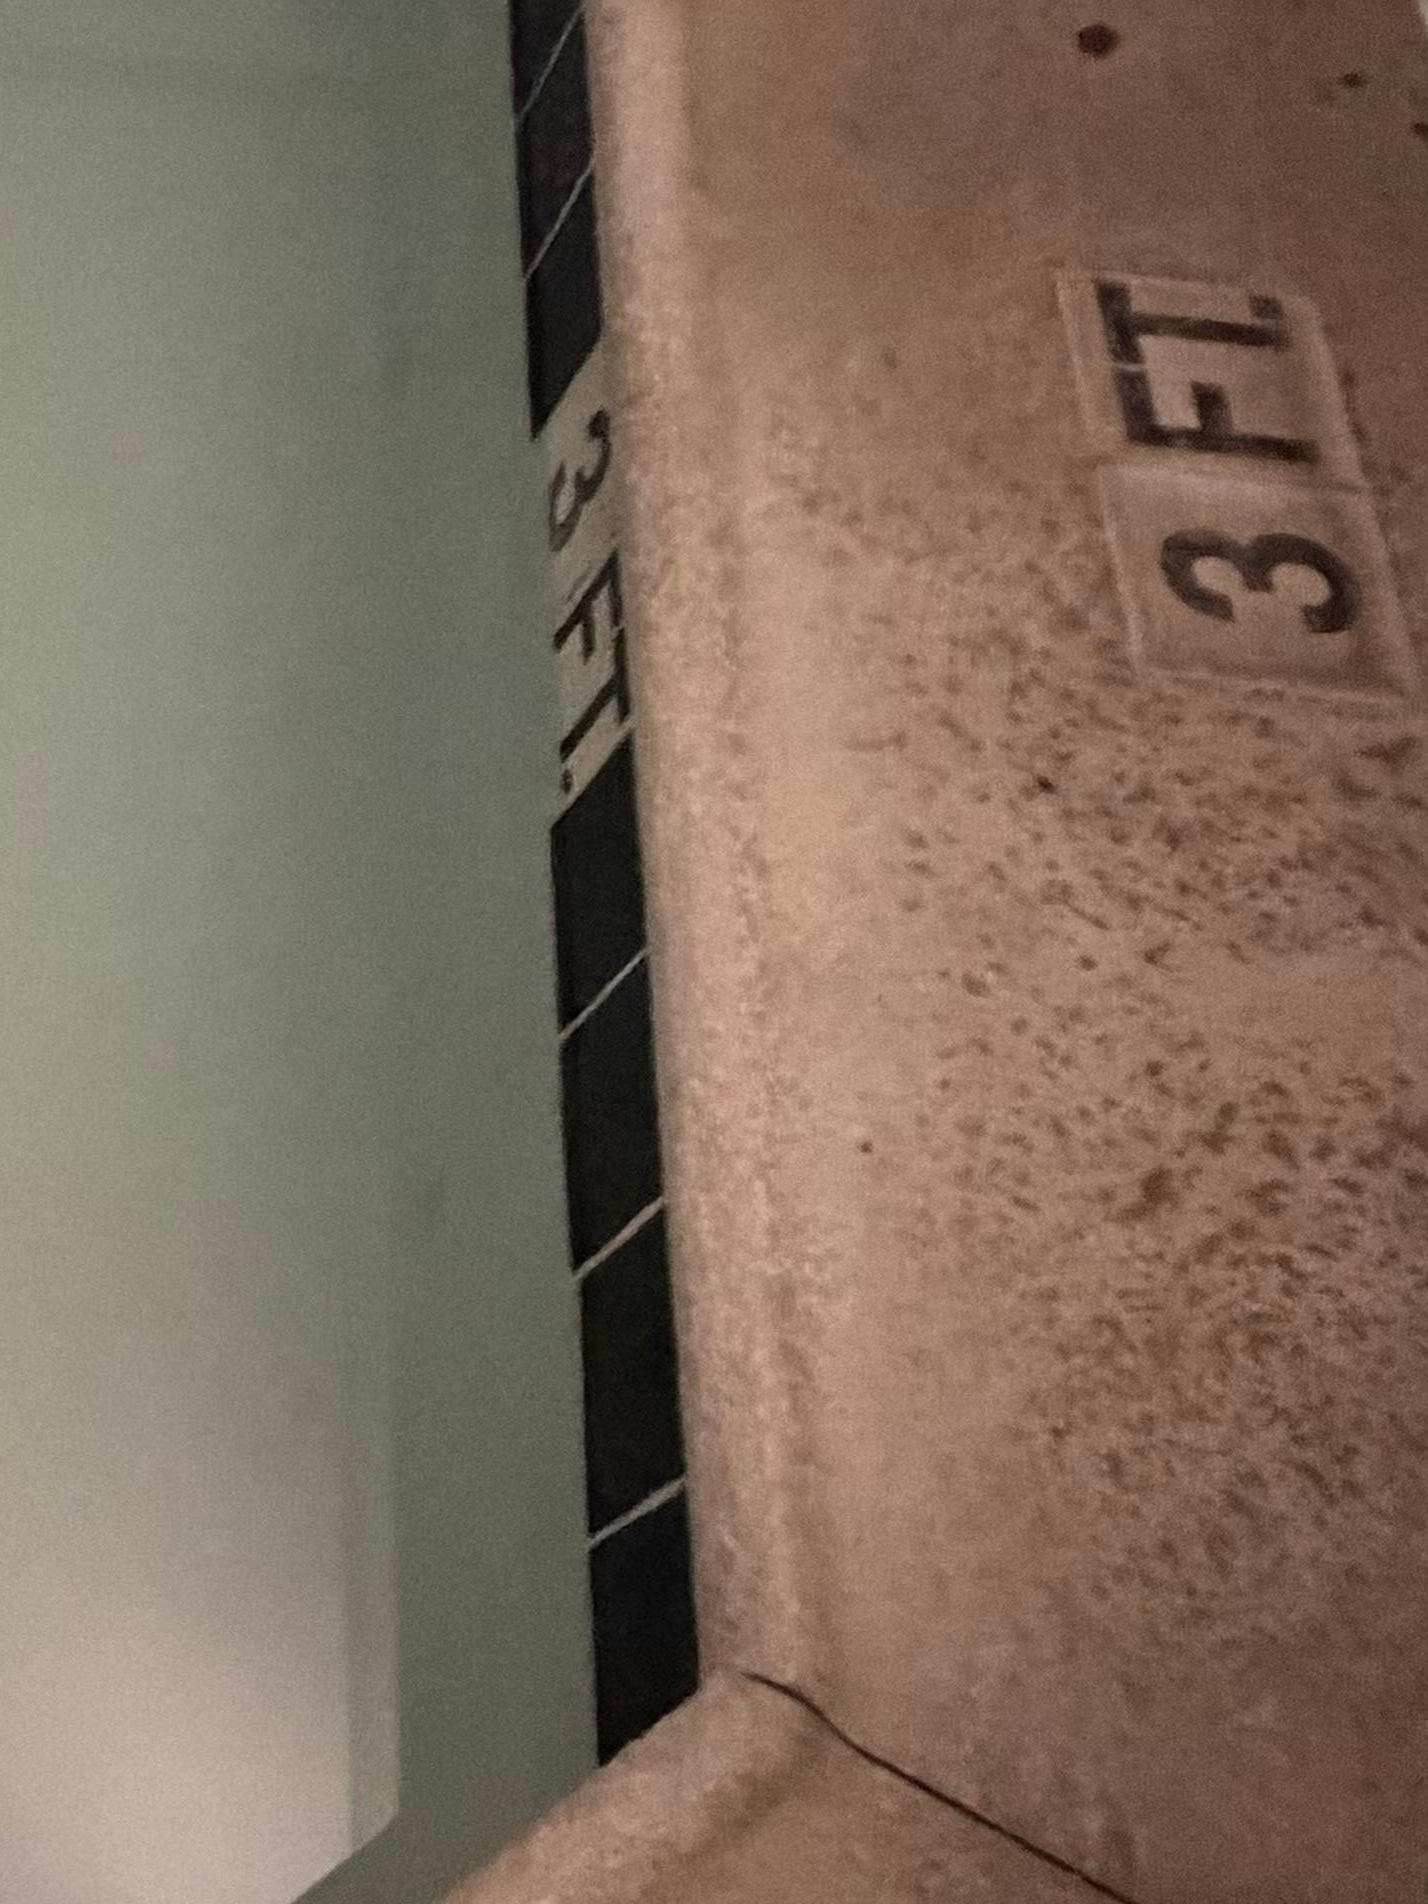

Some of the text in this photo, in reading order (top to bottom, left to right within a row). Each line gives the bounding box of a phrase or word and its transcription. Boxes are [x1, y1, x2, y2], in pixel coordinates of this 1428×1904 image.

[548, 408, 631, 795] 3 FT.
[1095, 276, 1363, 634] 3 FT.
